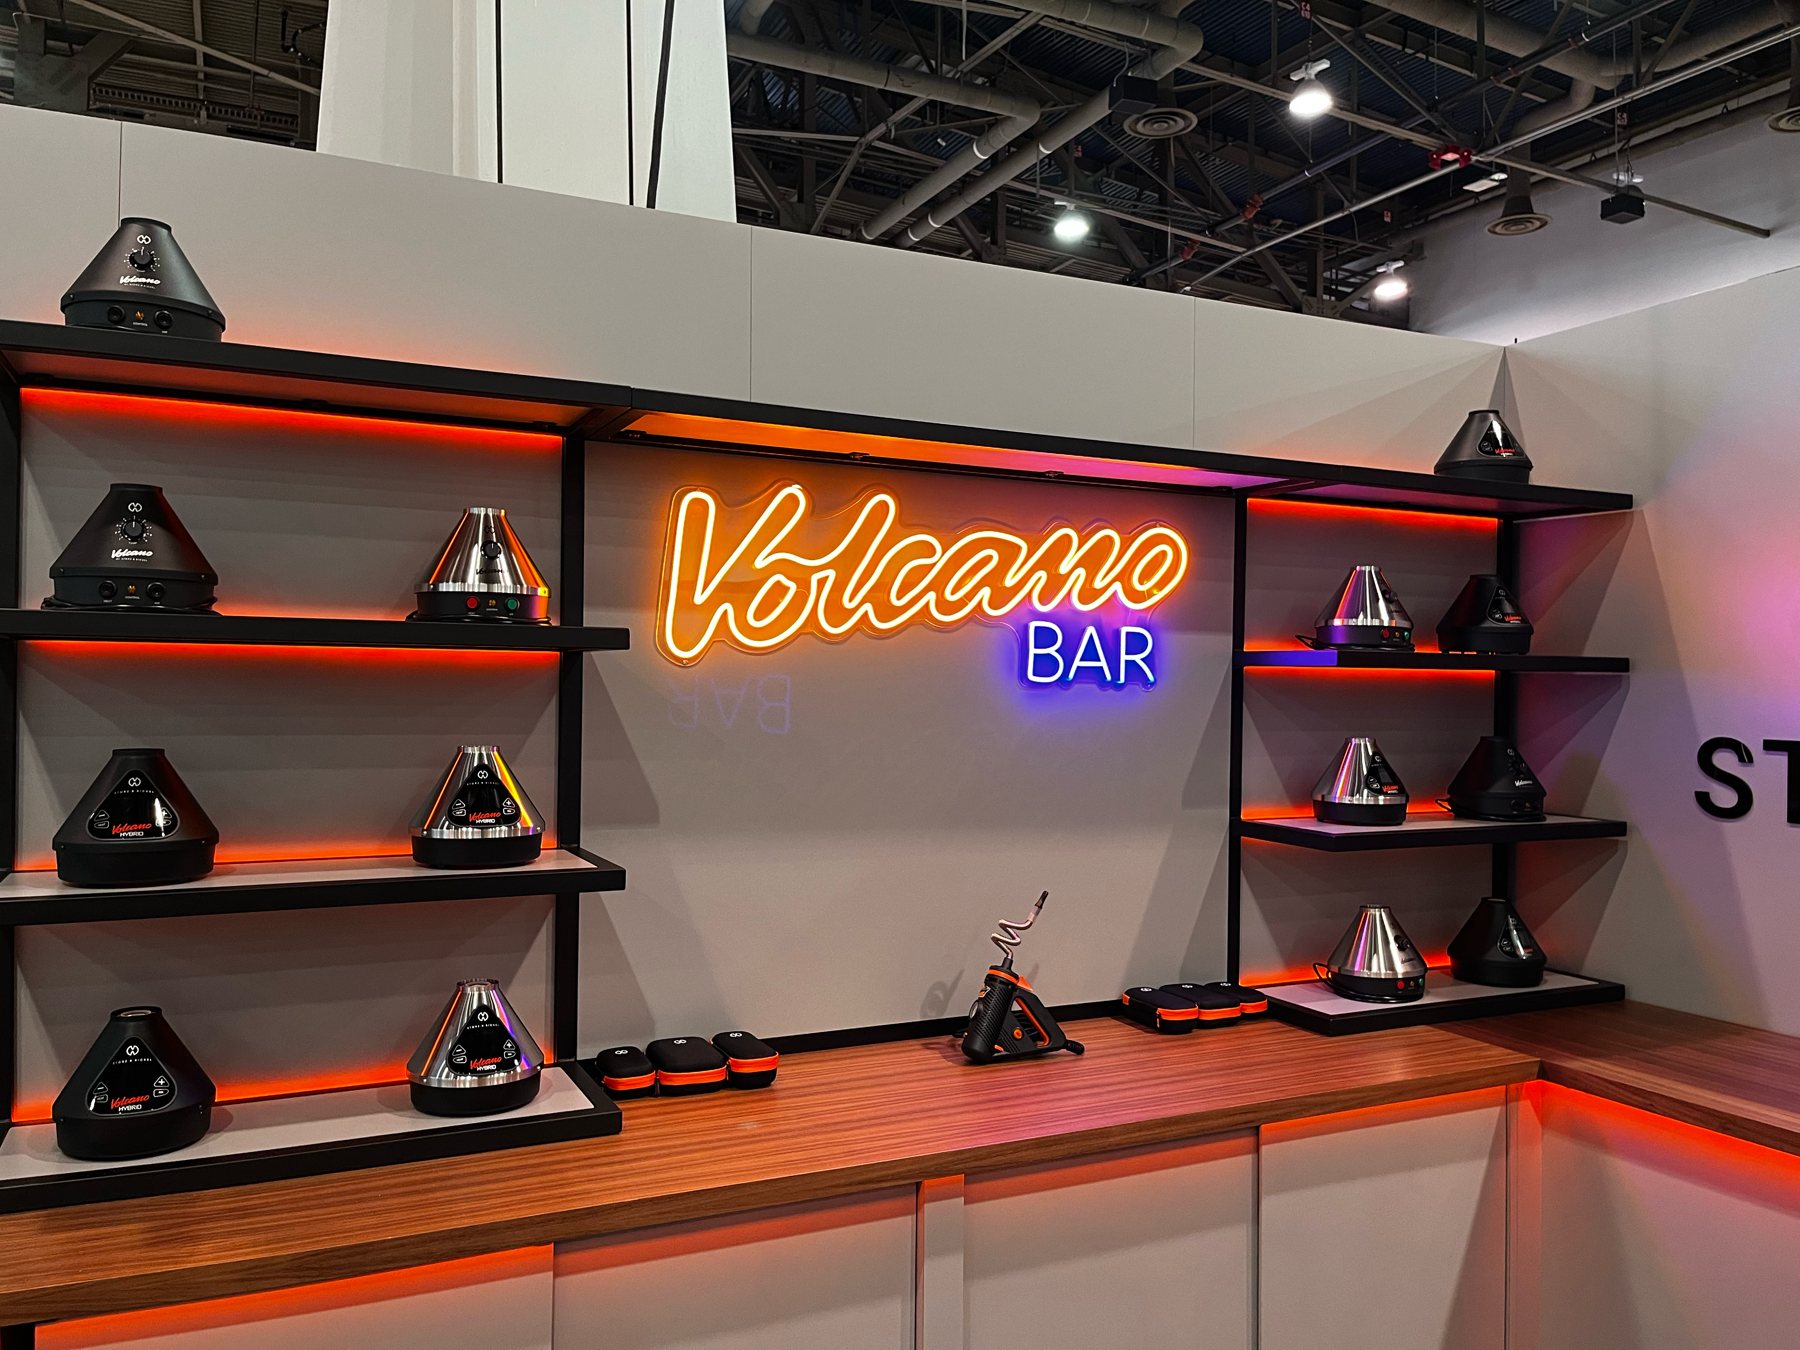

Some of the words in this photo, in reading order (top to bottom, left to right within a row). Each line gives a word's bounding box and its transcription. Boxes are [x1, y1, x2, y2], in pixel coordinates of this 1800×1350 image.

[119, 275, 161, 285] Volcano
[111, 548, 153, 559] Volcano
[665, 486, 1188, 658] Volcano
[1027, 620, 1155, 684] BAR
[469, 811, 502, 822] Volcano
[112, 822, 152, 835] Volcano
[470, 1057, 502, 1069] Volcano
[111, 1095, 150, 1109] Volcano
[118, 1104, 142, 1112] HYBRID
